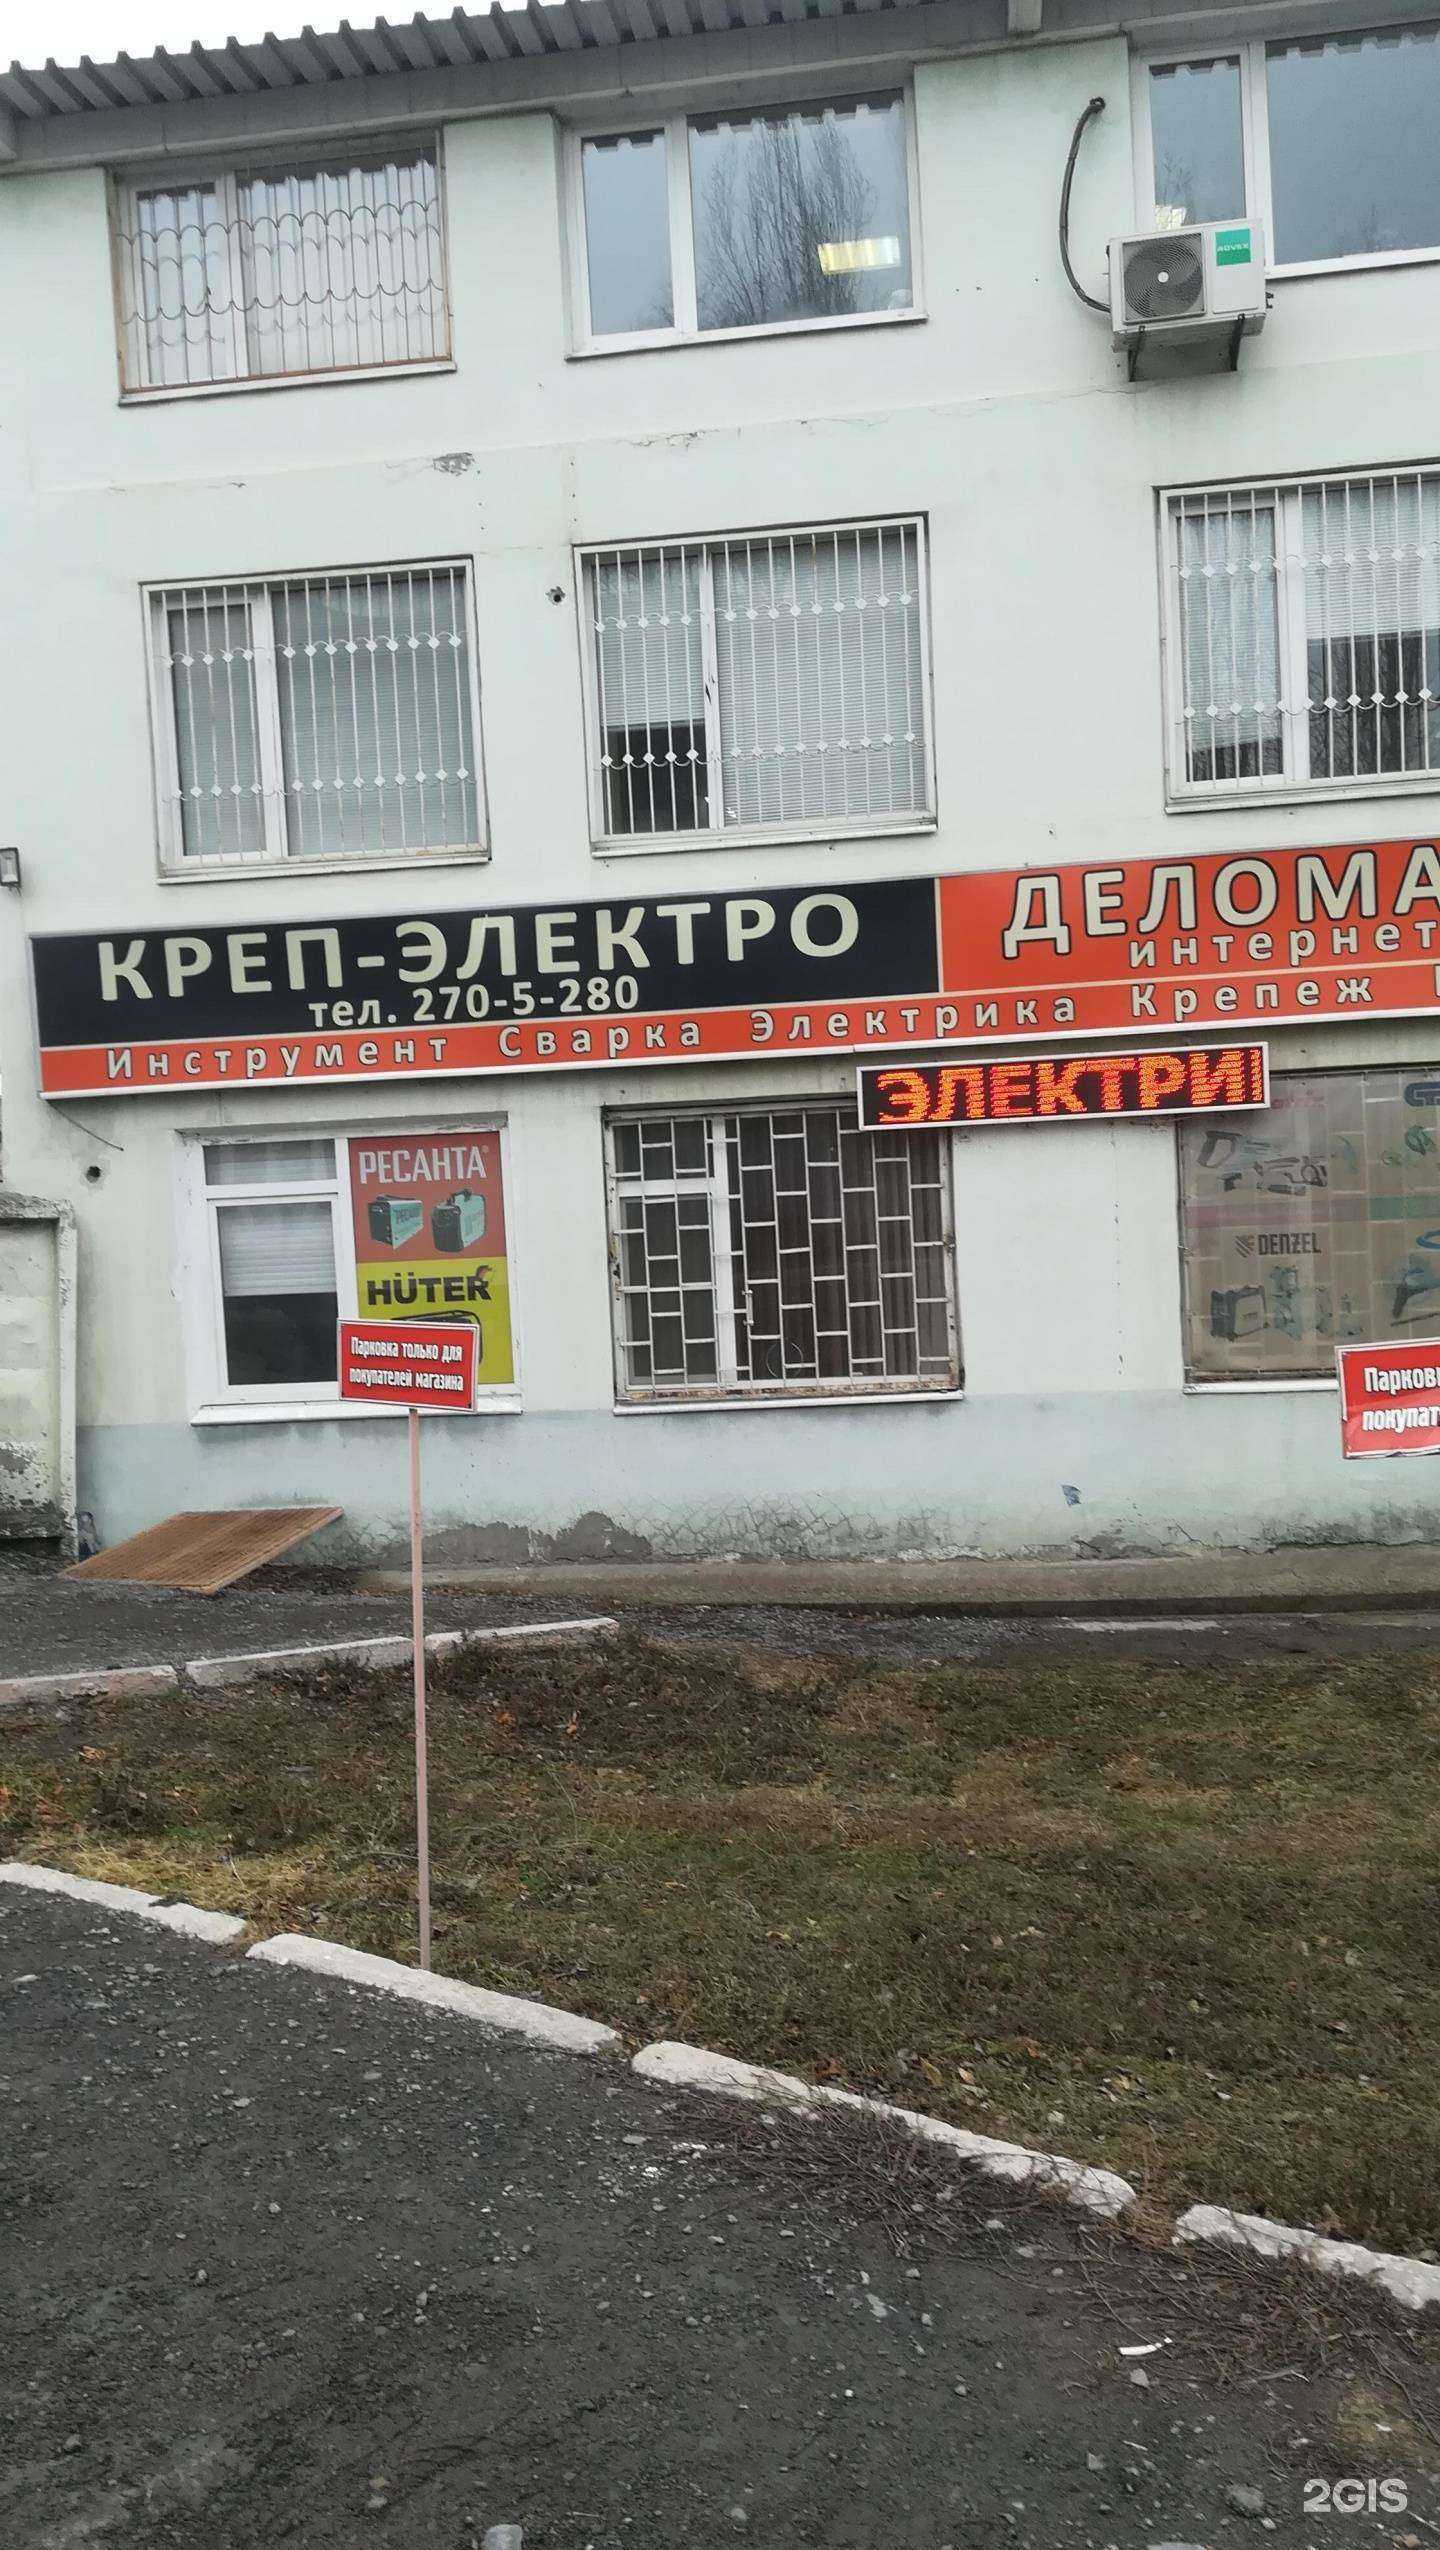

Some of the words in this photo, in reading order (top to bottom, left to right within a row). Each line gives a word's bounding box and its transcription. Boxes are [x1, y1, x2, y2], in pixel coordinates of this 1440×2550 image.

[1001, 845, 1440, 960] ДЕЛОМА
[98, 893, 860, 1001] КРЕП-ЭЛЕКТРО
[1129, 920, 1438, 969] интернет
[309, 997, 397, 1028] тел.
[412, 974, 639, 1024] 270-5-280
[105, 1033, 449, 1080] Инструмент
[498, 1018, 701, 1060] Сварка
[749, 992, 1076, 1043] Электрика
[1130, 976, 1373, 1023] Крепеж
[358, 1146, 488, 1185] РЕСАНТА
[1258, 1231, 1322, 1256] DENZEL
[366, 1271, 492, 1306] HÜTER
[351, 1335, 399, 1359] Парковка
[402, 1341, 439, 1360] только
[441, 1344, 463, 1363] для
[349, 1367, 413, 1387] покупателей
[415, 1370, 464, 1391] магазина
[1363, 1365, 1440, 1396] Парков
